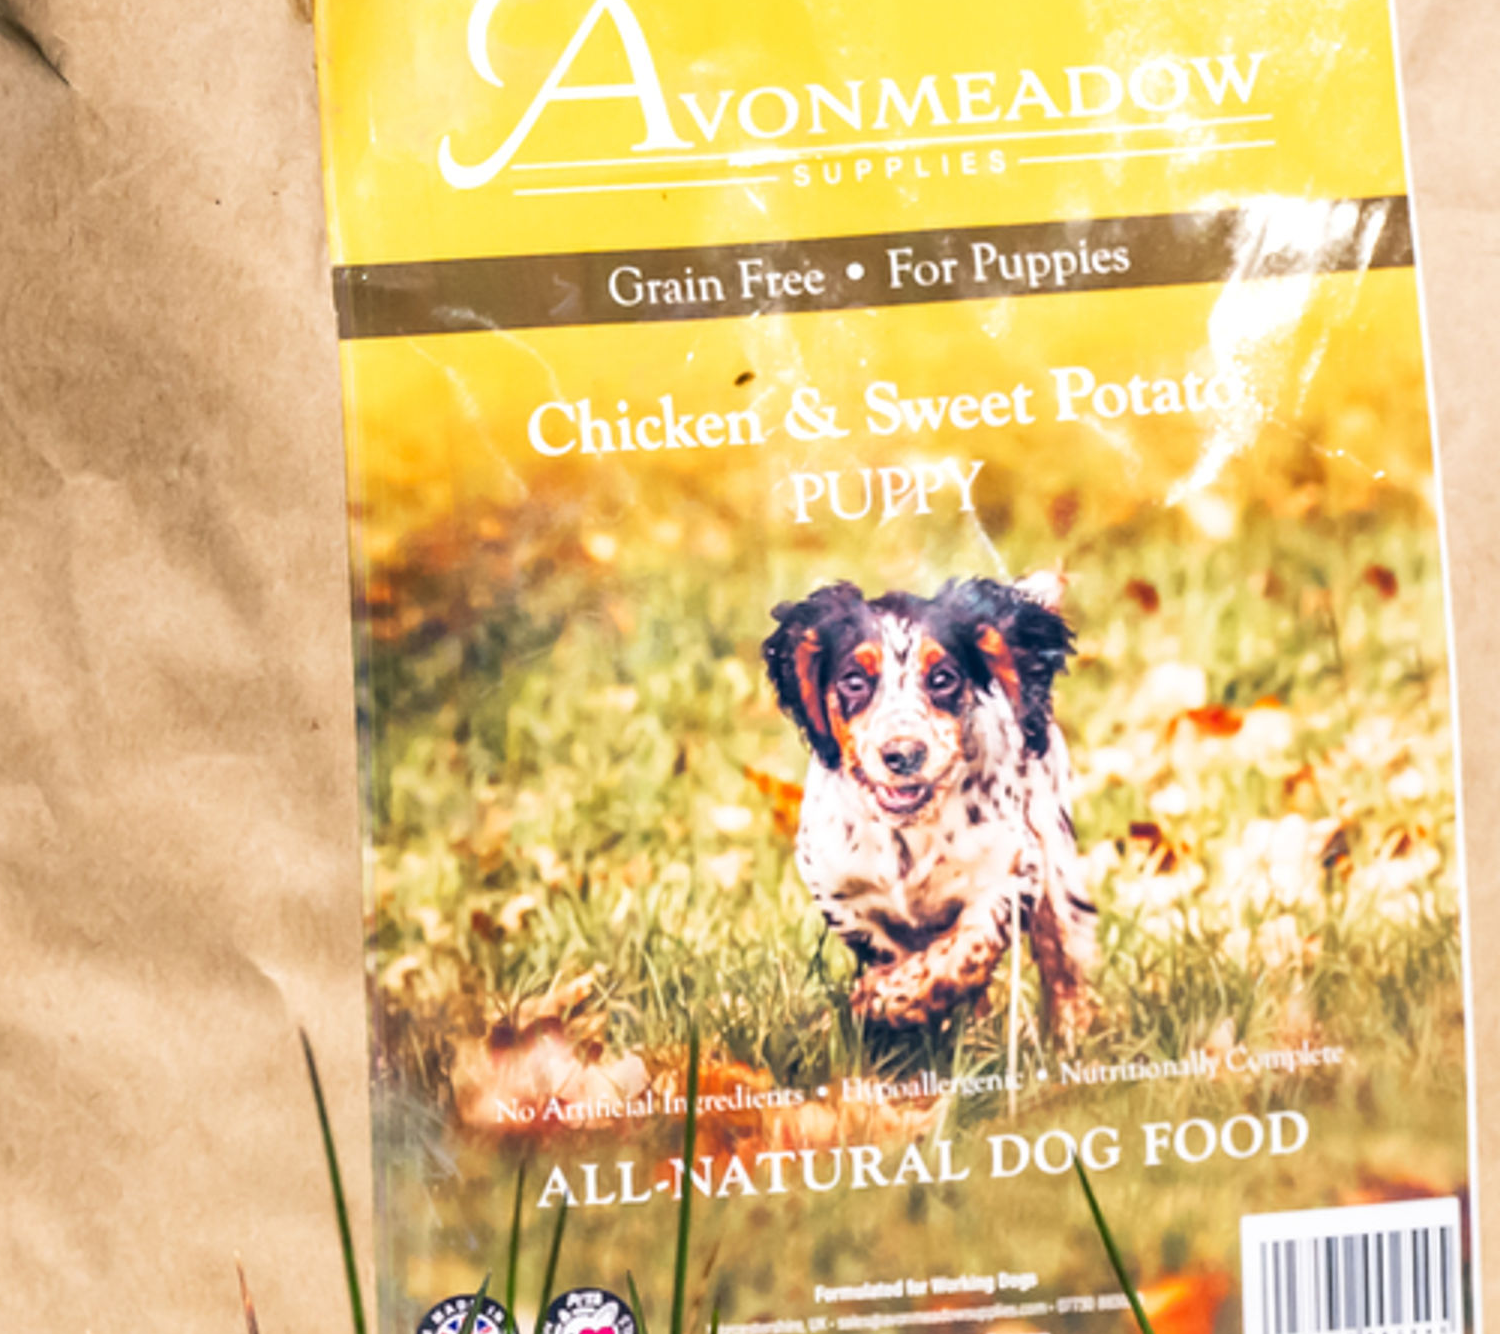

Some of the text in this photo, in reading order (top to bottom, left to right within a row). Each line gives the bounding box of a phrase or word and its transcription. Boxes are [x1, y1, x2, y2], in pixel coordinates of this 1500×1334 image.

[792, 149, 1008, 187] SUPPLIES
[608, 238, 1131, 308] Grain Free For Puppies
[526, 366, 1244, 457] Chicken & Sweet Potato
[791, 460, 985, 525] PUPPY
[496, 1096, 536, 1124] No
[541, 1087, 654, 1123] Artificial
[662, 1079, 806, 1116] Ingredients
[1060, 1047, 1218, 1085] Nutritionally
[1225, 1040, 1346, 1074] Complete
[536, 1109, 1311, 1209] ALL-NATURAL DOG FOOD
